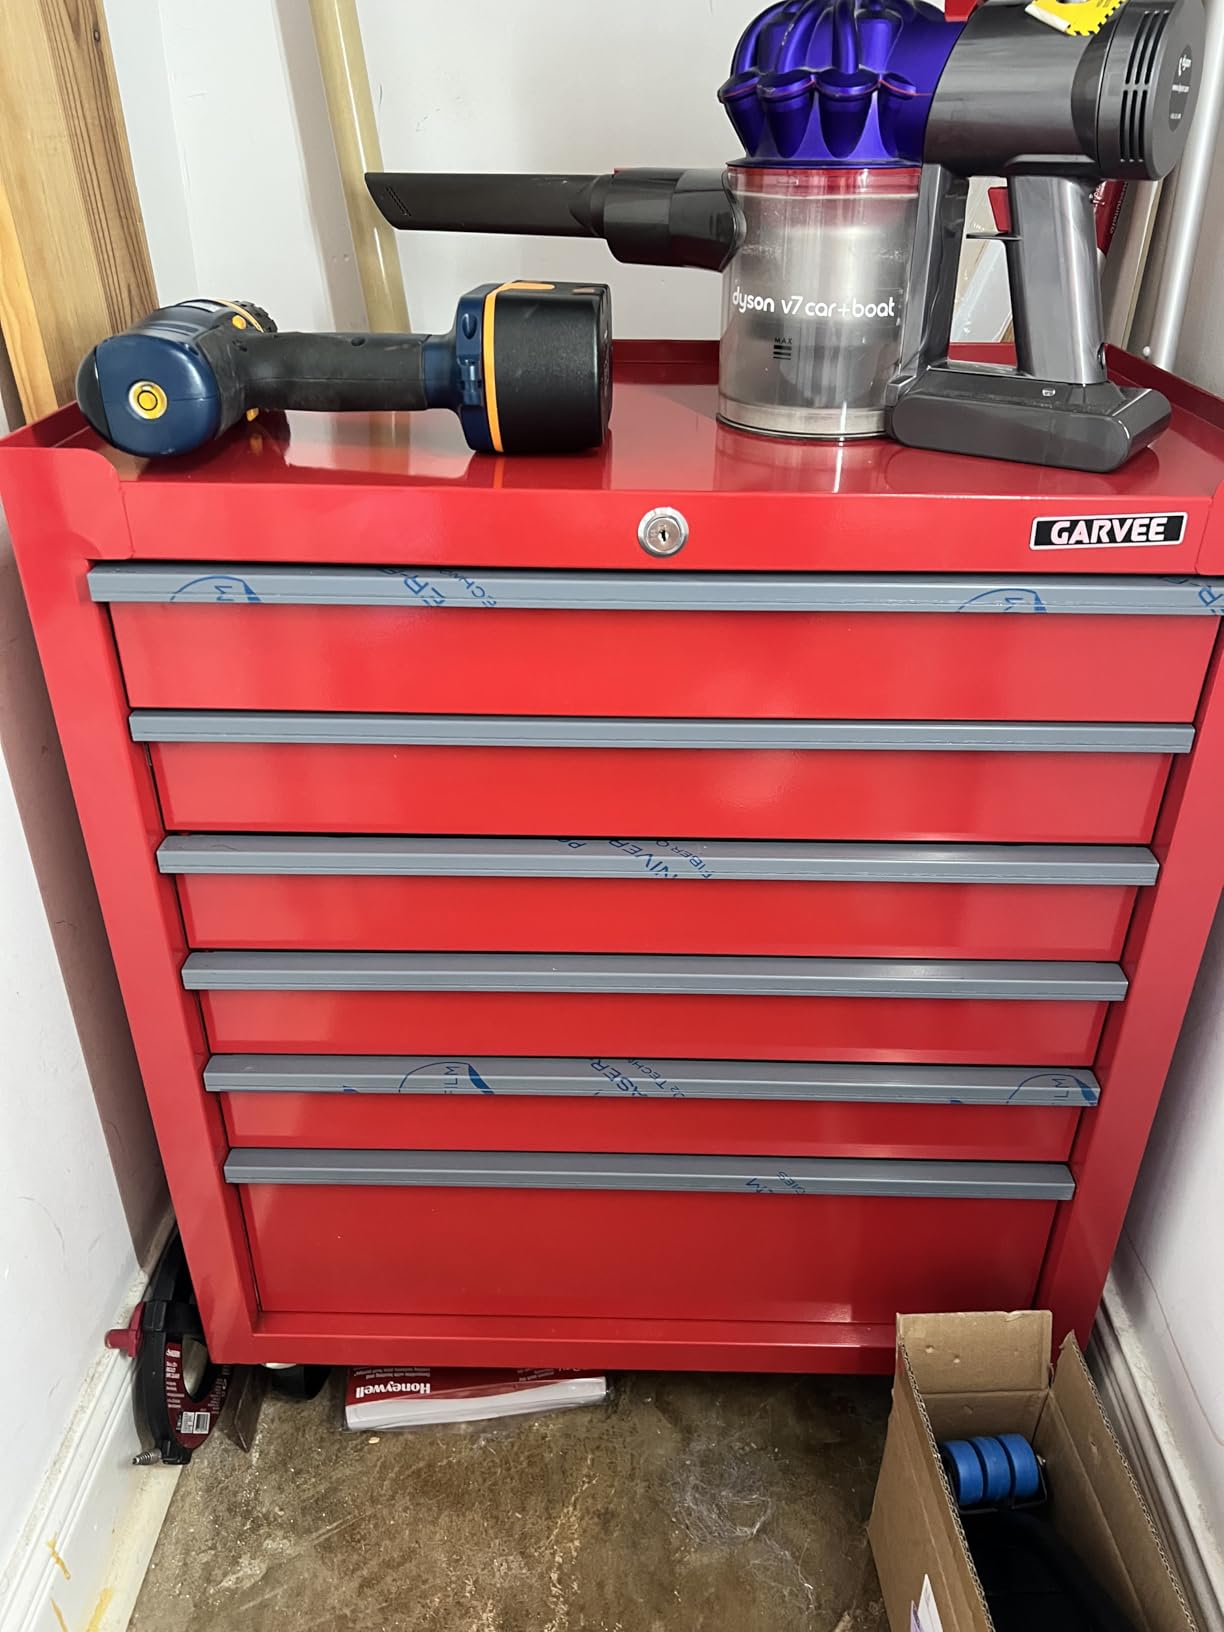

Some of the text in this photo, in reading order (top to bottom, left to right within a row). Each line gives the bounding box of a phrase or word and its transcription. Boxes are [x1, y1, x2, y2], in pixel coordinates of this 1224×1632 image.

[731, 286, 895, 318] dyson v7 car+boat
[774, 337, 793, 345] MAX
[1050, 517, 1168, 545] GARVEE
[355, 1381, 431, 1399] Honeywell
